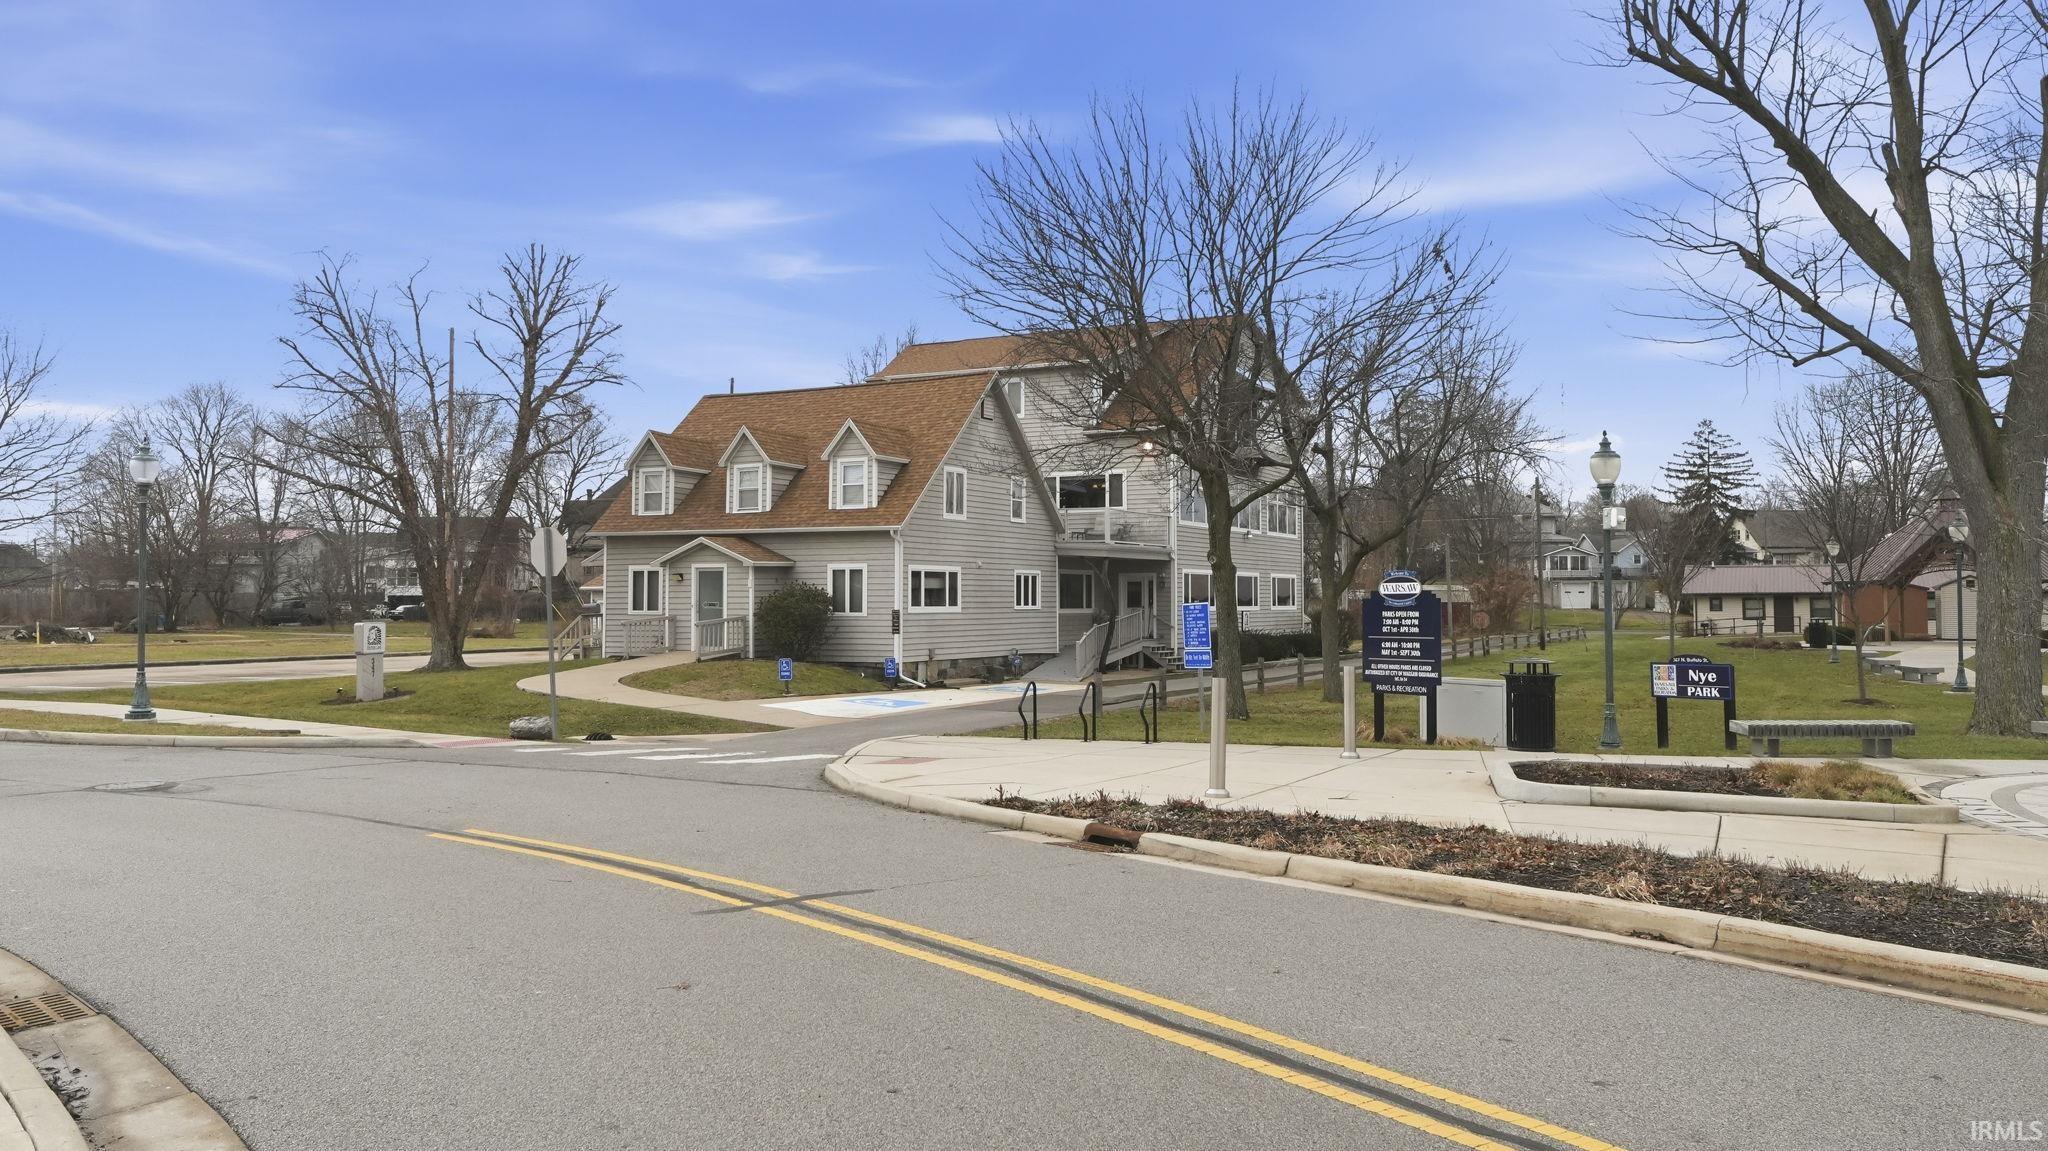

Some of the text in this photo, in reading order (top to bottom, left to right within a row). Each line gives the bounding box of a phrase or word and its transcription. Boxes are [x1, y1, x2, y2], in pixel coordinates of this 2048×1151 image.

[1382, 583, 1419, 593] WARSAW
[1688, 669, 1717, 684] Nye
[1687, 686, 1720, 697] PARK
